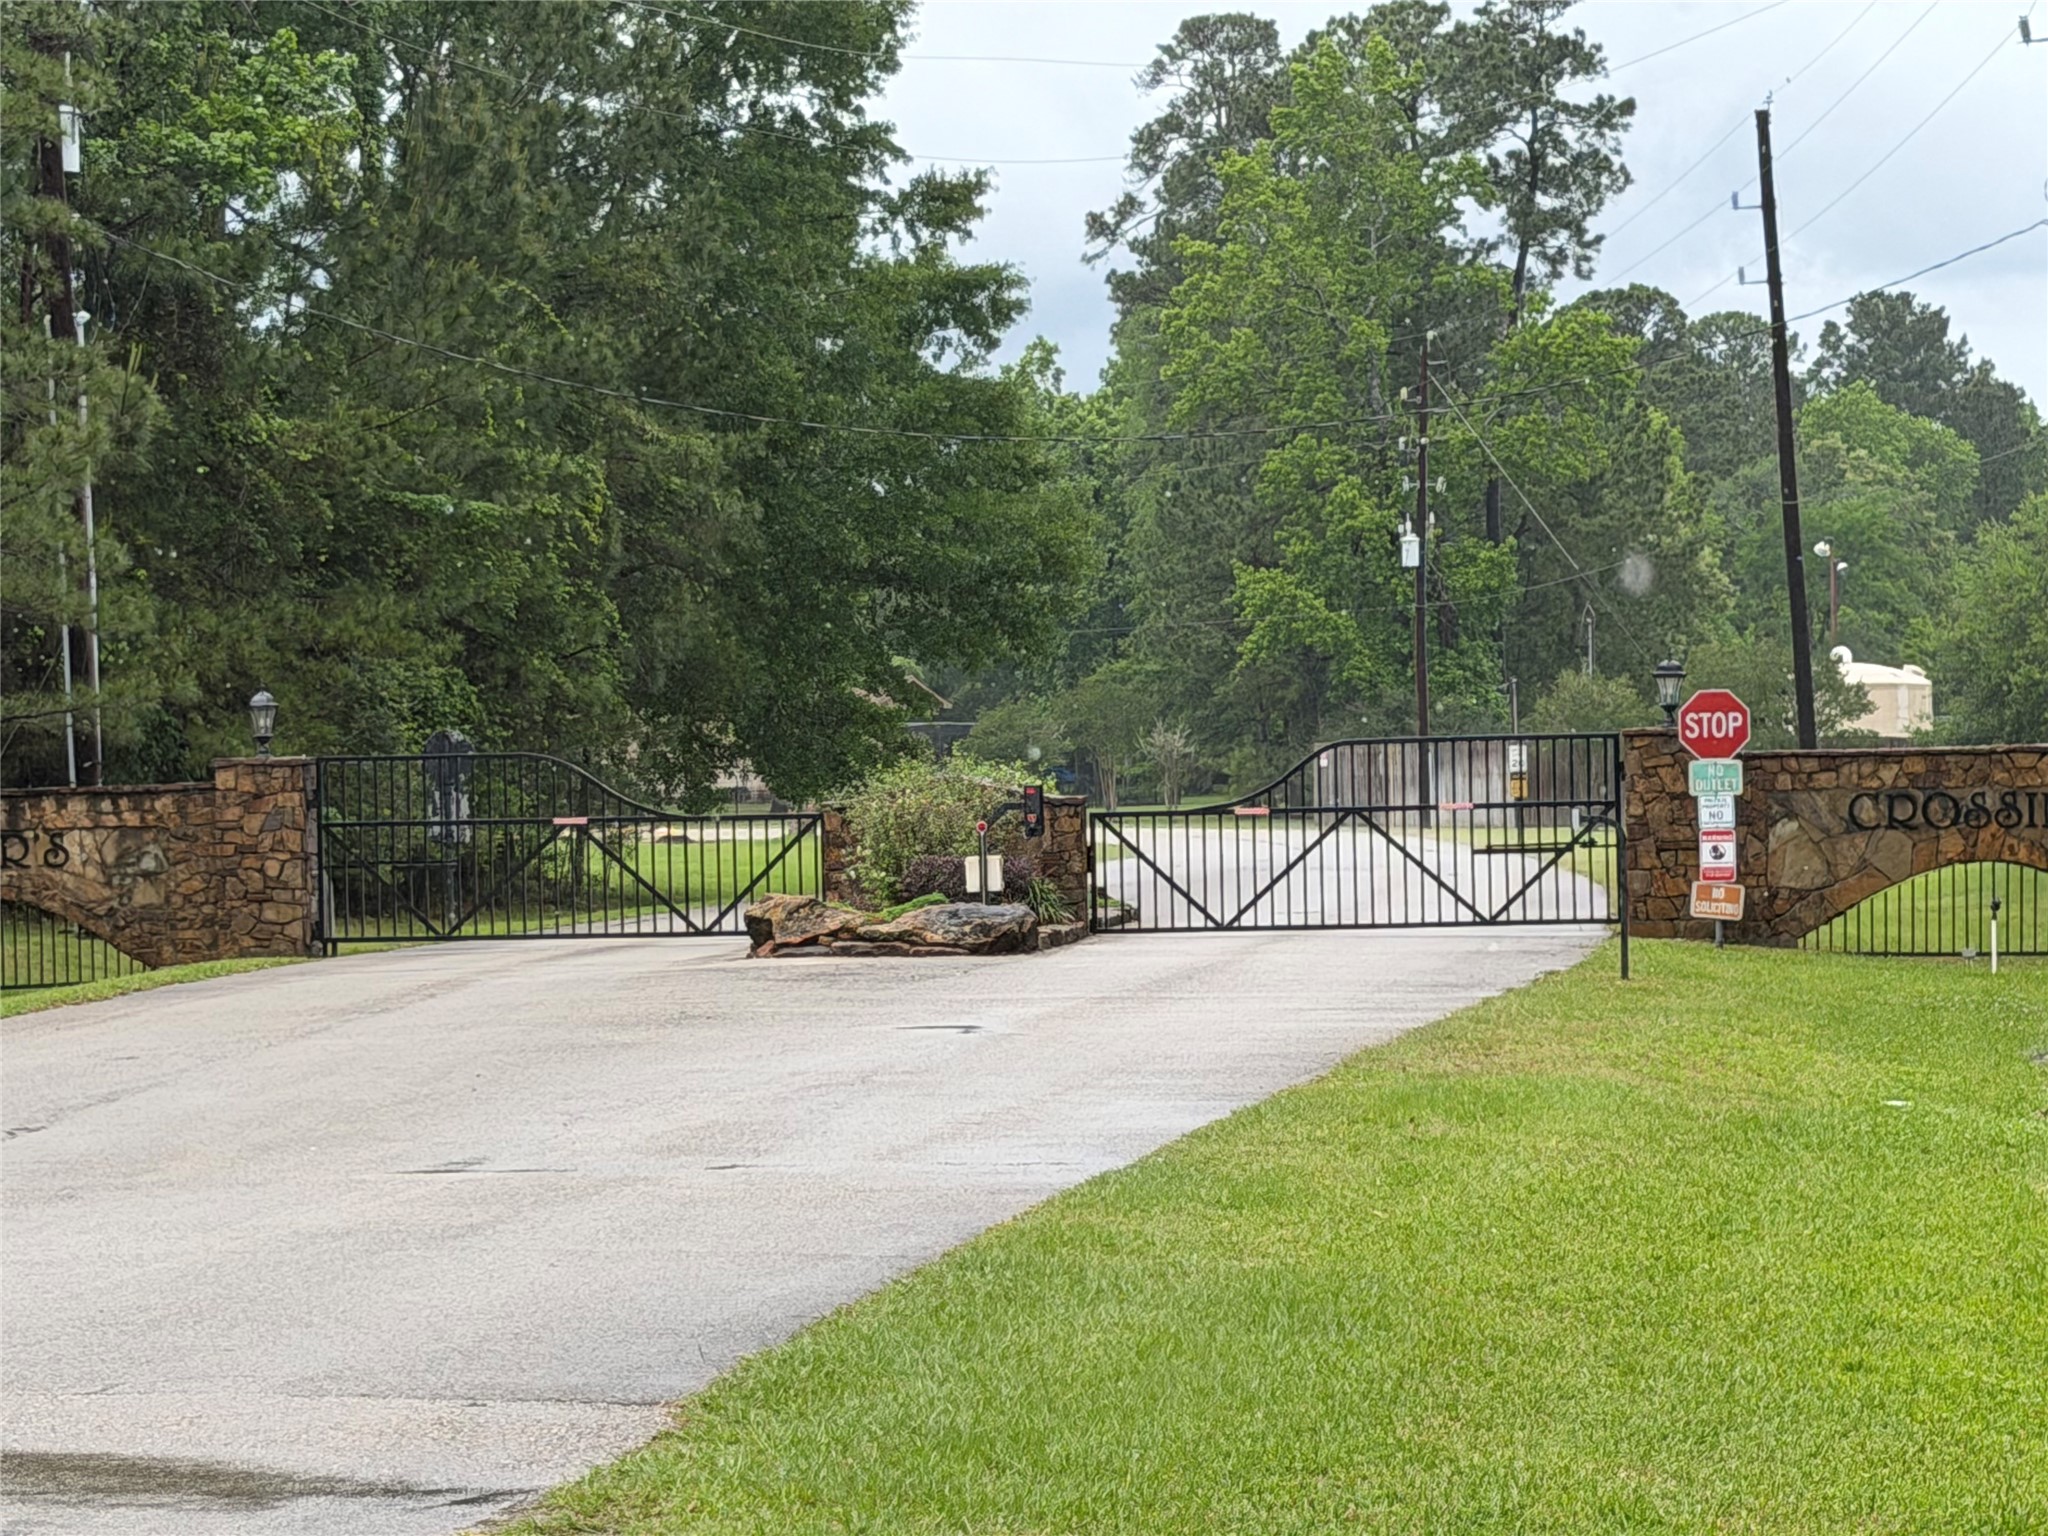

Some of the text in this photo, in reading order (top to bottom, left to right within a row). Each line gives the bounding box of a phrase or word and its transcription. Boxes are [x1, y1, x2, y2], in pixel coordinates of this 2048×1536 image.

[1685, 711, 1743, 738] STOP
[1707, 764, 1724, 777] NO
[1695, 779, 1737, 791] OUTLET
[1708, 810, 1724, 820] NO
[1711, 886, 1725, 899] NO
[1695, 900, 1739, 915] SOLICITING
